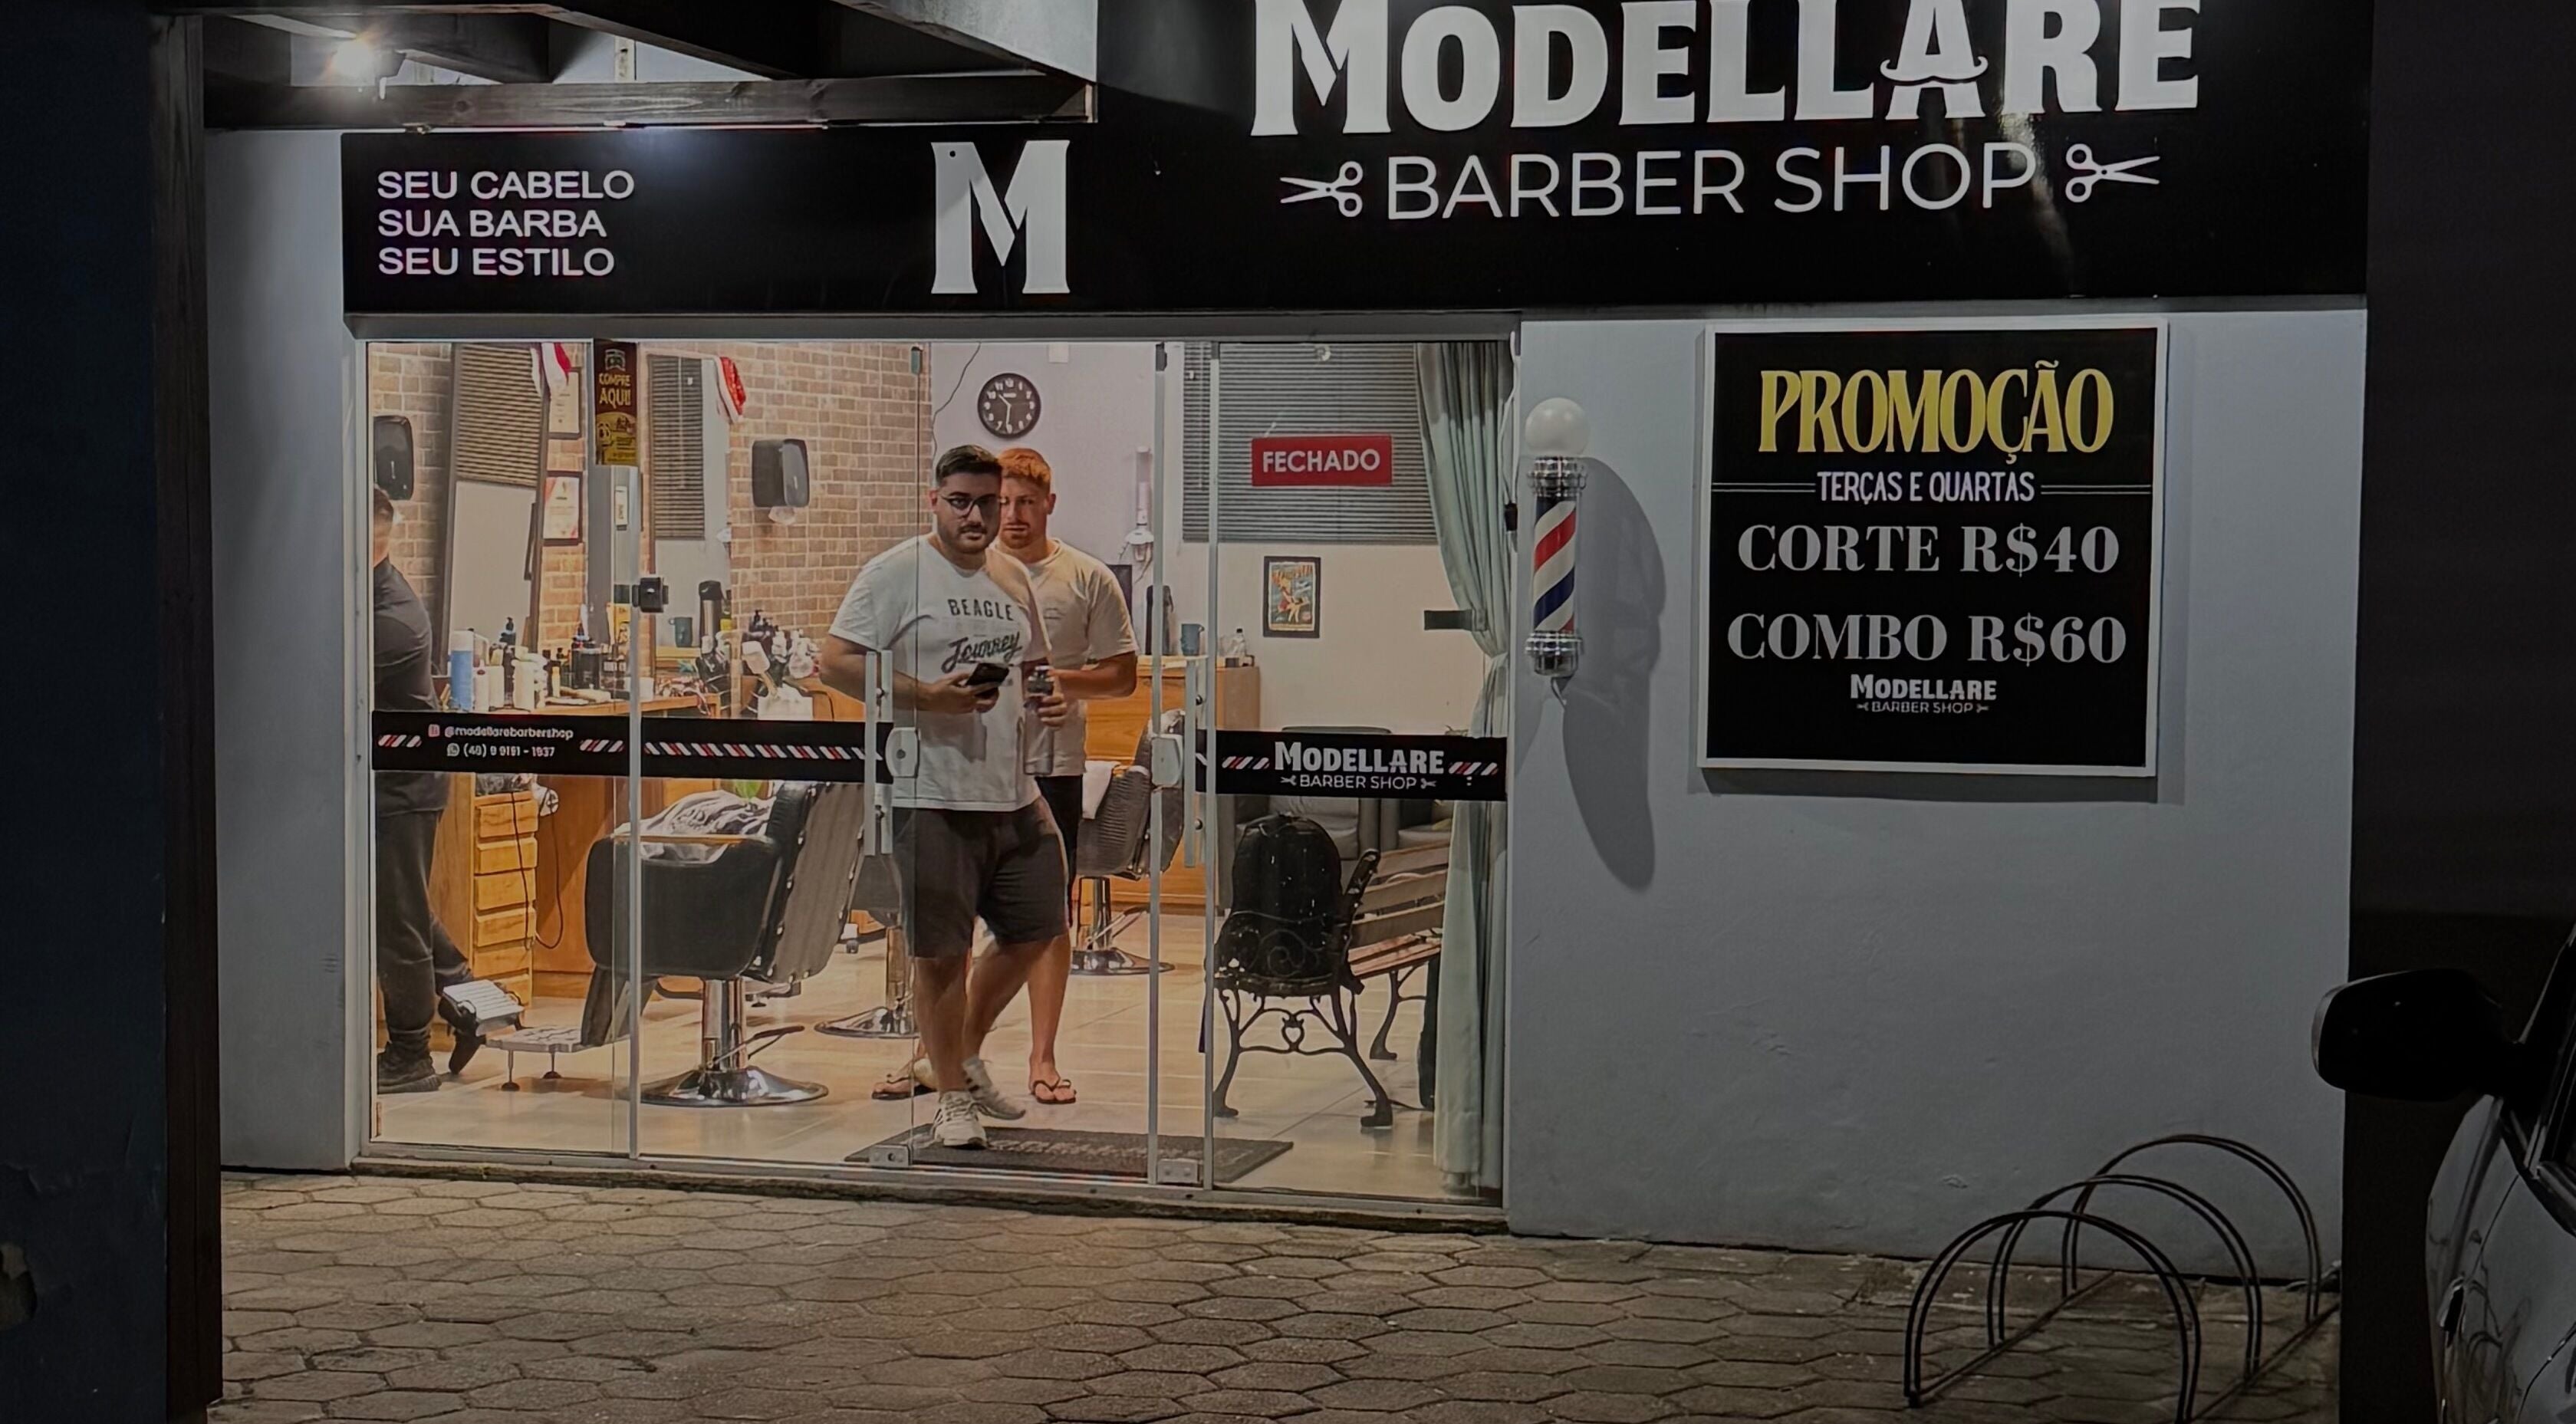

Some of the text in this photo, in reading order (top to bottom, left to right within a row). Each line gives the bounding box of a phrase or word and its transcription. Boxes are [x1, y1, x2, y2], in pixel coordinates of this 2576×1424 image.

[1250, 0, 2200, 136] MODELLARE
[378, 170, 634, 199] SEU CABELO
[1389, 140, 2039, 219] BARBER SHOP
[379, 209, 607, 237] SUA BARBA
[931, 140, 1070, 294] M
[379, 247, 614, 276] SEU ESTILO
[599, 373, 631, 386] COMPRE
[1758, 360, 2114, 464] PROMOÇÃO
[1262, 449, 1380, 472] FECHADO
[1817, 472, 2035, 505] TERÇAS E QUARTAS
[1739, 523, 2119, 577] CORTE R$40
[948, 599, 1014, 621] BEAGLE
[1728, 613, 2126, 666] COMBO R$60
[1851, 674, 1996, 700] MODELLARE
[1872, 702, 1973, 713] BARBER SHOP
[1275, 742, 1443, 773] MODELLARE
[1301, 775, 1416, 788] BARBER SHOP
